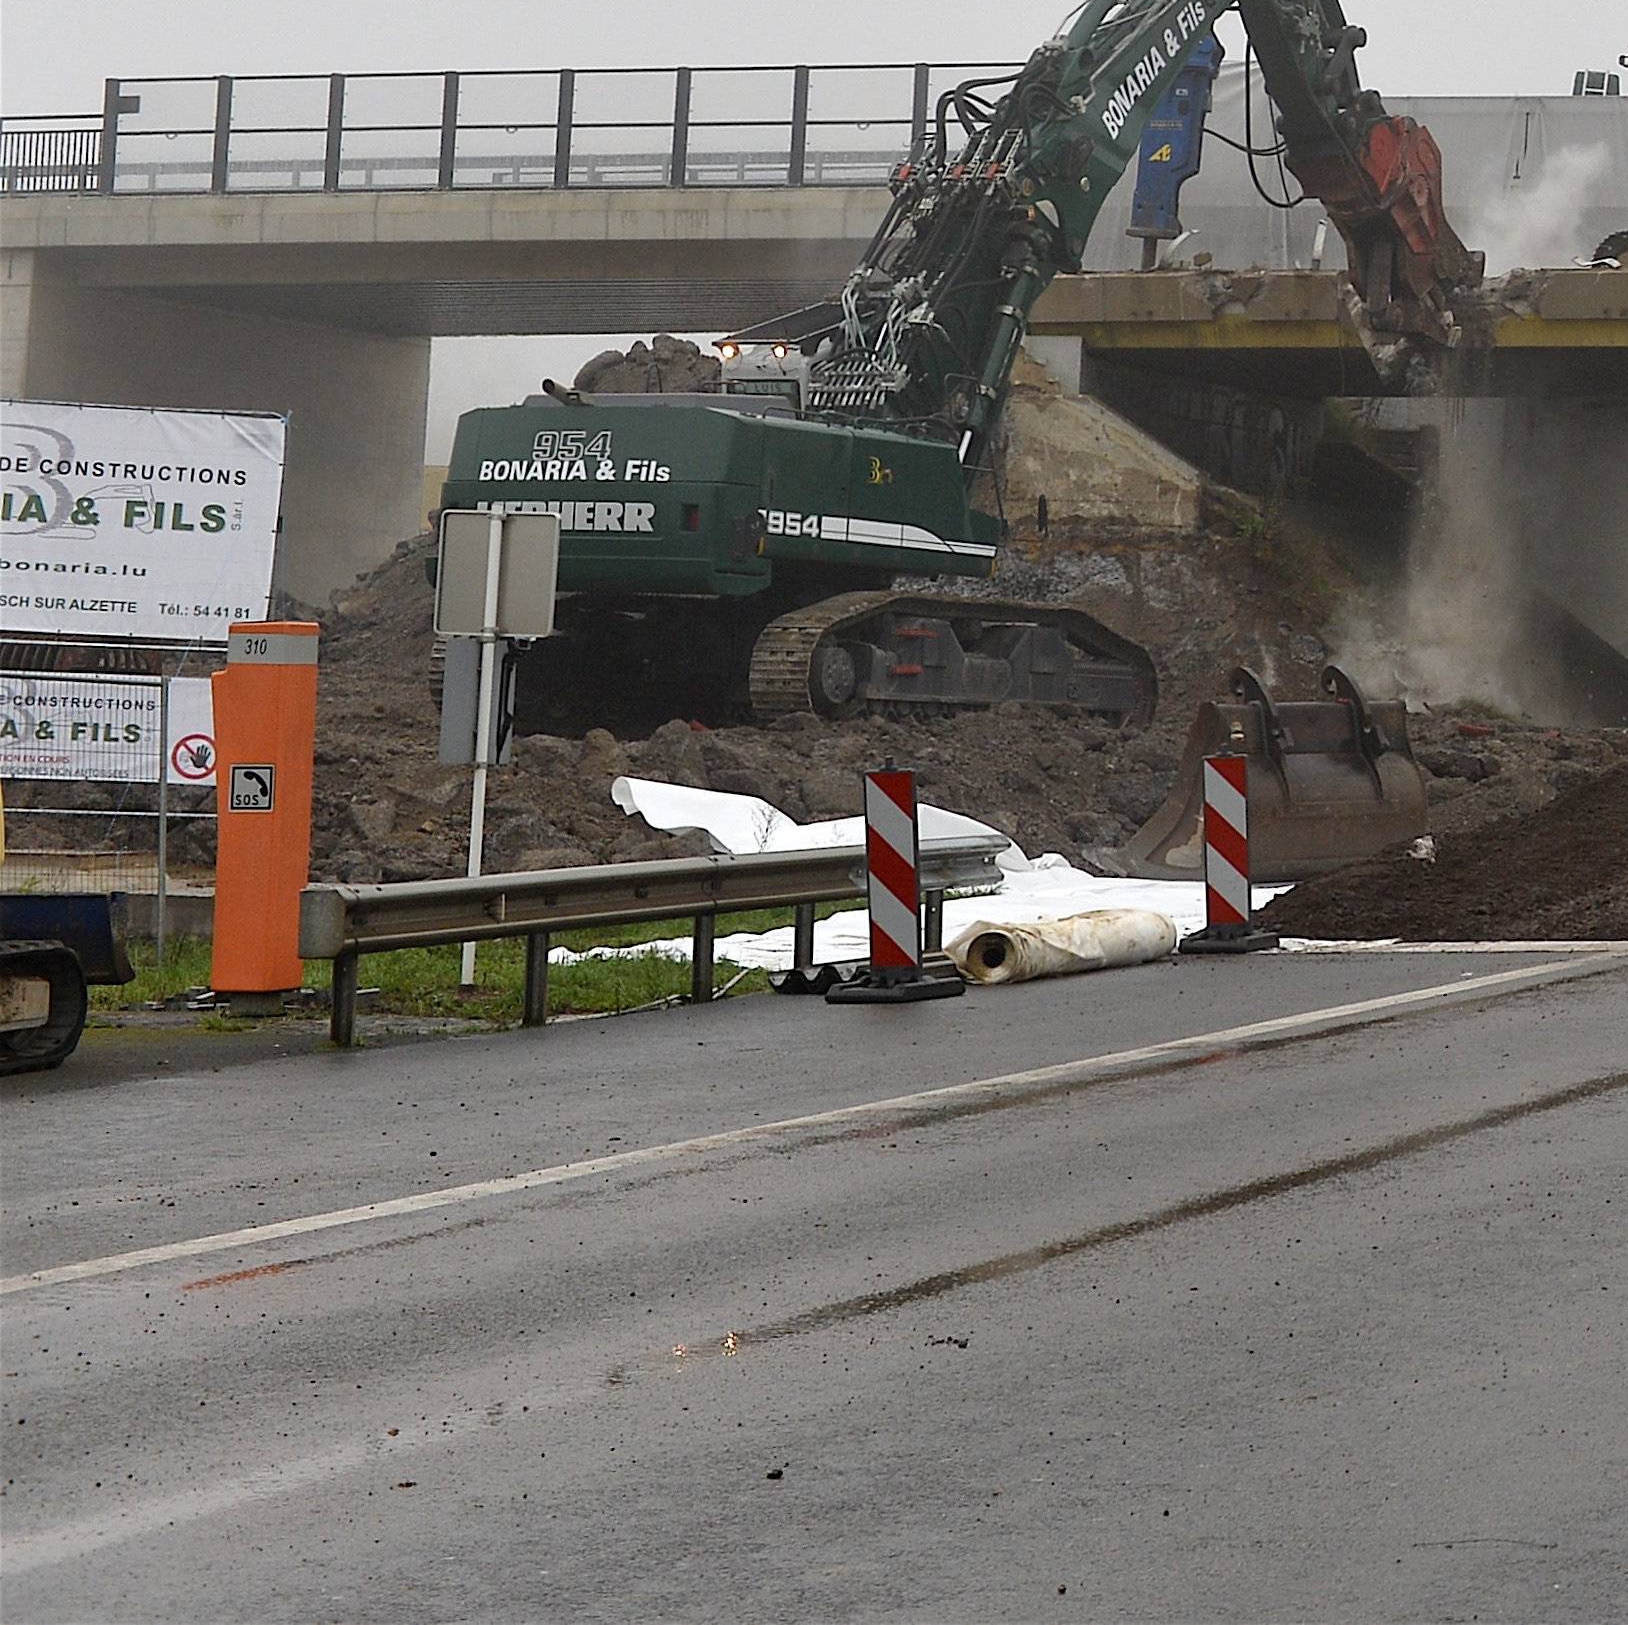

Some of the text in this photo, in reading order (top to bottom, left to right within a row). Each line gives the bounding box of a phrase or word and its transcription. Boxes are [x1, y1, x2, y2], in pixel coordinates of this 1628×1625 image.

[1101, 46, 1167, 140] BONARIA
[1163, 28, 1181, 58] &
[1176, 0, 1206, 41] Fils
[532, 430, 612, 461] 954
[0, 457, 247, 486] DE CONSTRUCTIONS
[479, 460, 670, 482] BONARIA & Fils
[71, 496, 100, 526] &
[124, 500, 226, 533] FILS
[477, 501, 655, 532] HERR
[768, 509, 820, 538] 954
[34, 596, 66, 610] SUR
[68, 599, 137, 613] ALZETTE
[193, 605, 209, 617] 54
[214, 606, 228, 618] 41
[234, 607, 250, 619] 81
[244, 638, 267, 655] 310
[13, 695, 156, 711] CONSTRUCTIONS
[35, 720, 55, 740] &
[70, 722, 141, 743] FILS
[235, 795, 259, 806] SOS
